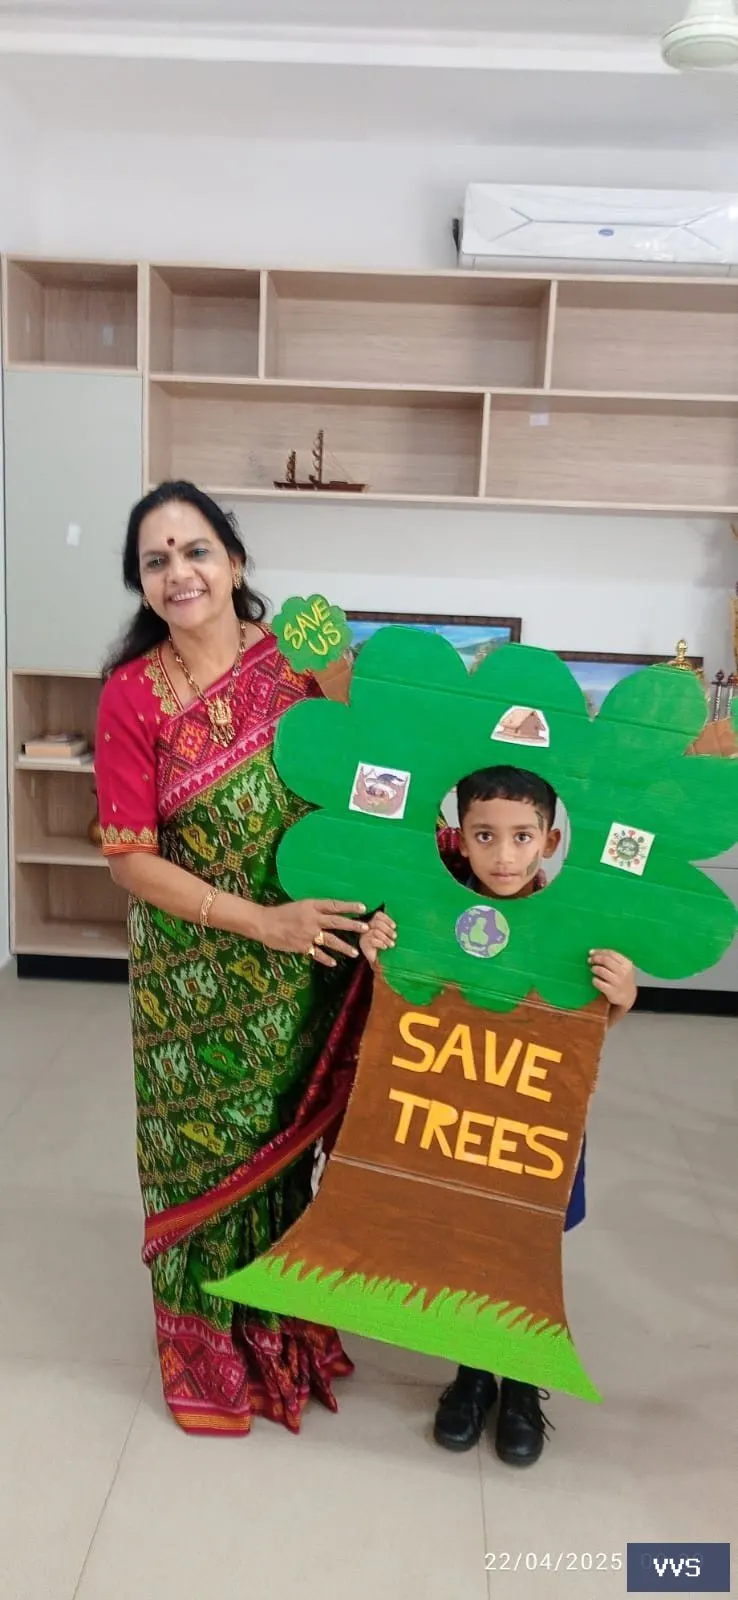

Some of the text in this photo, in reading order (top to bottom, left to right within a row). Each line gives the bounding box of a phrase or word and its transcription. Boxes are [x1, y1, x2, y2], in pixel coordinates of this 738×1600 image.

[284, 600, 330, 650] SAVE
[308, 621, 341, 655] US
[392, 1011, 563, 1103] SAVE
[389, 1088, 569, 1180] TREES
